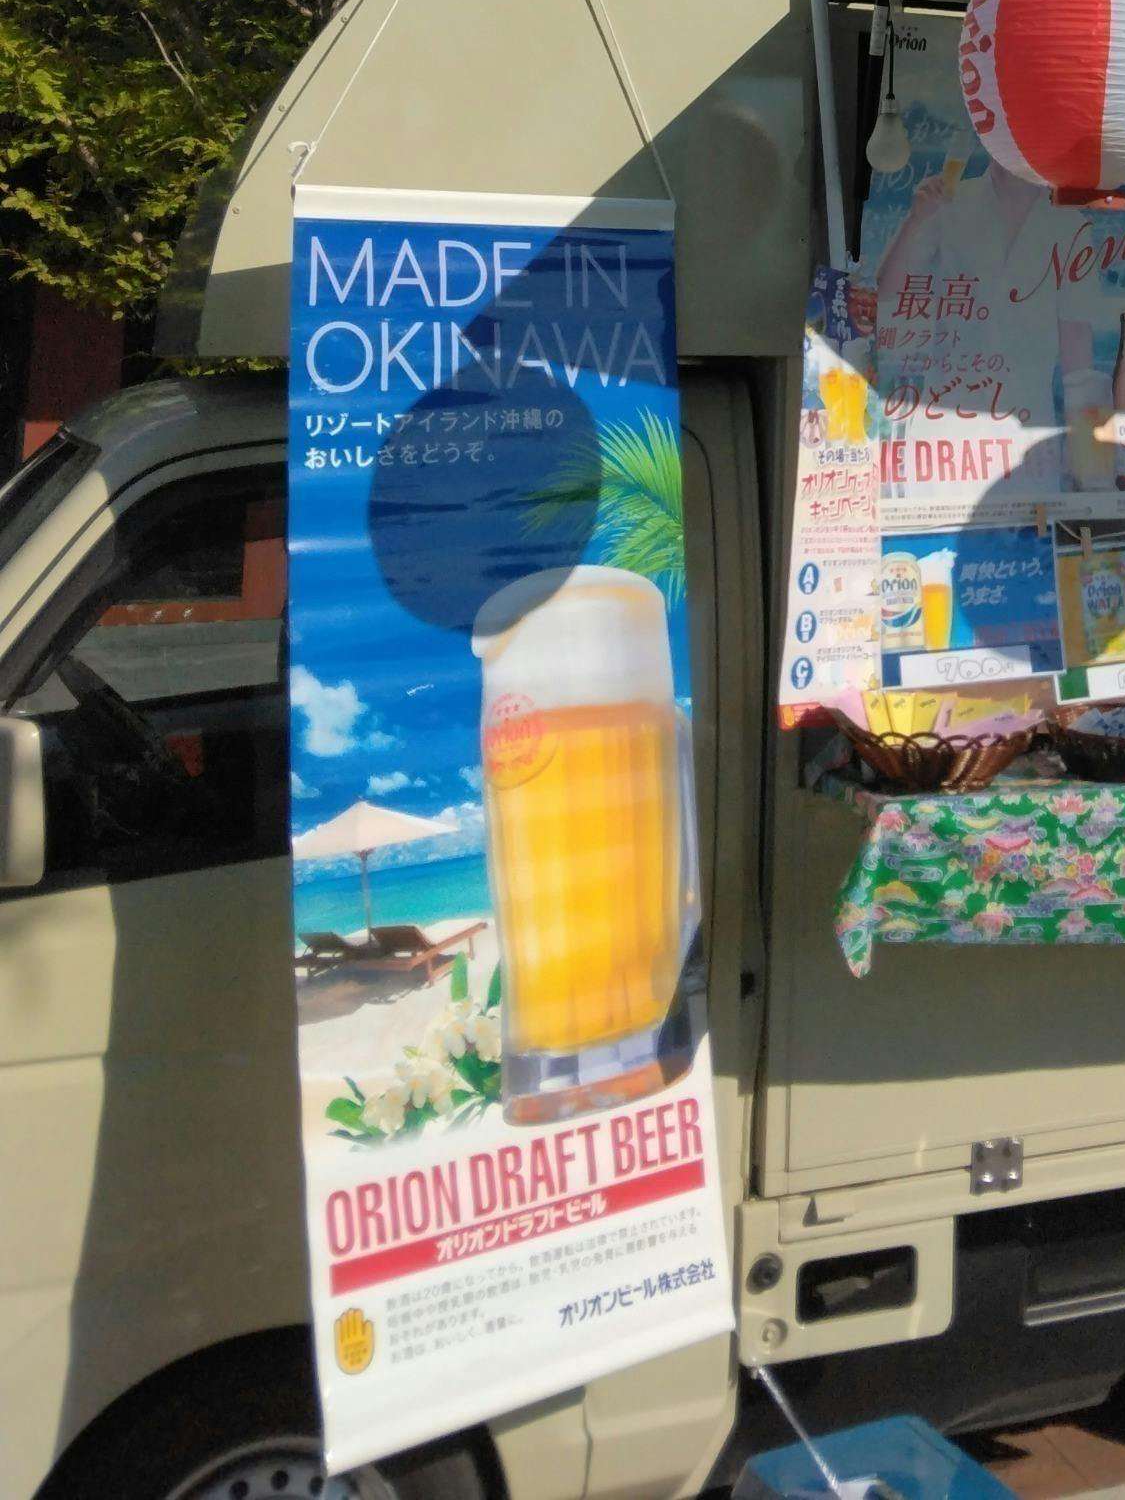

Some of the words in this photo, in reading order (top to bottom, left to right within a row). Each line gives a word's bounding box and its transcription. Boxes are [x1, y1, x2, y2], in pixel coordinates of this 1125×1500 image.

[308, 235, 533, 308] MADE
[564, 242, 630, 308] IN
[891, 273, 990, 321] 最高。
[305, 320, 667, 394] OKINAWA
[304, 408, 564, 438] リゾートアイランド沖縄の
[883, 376, 1032, 422] のどごし。
[303, 442, 497, 470] おいしさをどうぞ。
[914, 438, 1013, 484] DRAFT
[881, 577, 918, 594] Orion
[325, 1161, 462, 1257] ORION
[469, 1123, 602, 1216] DRAFT
[611, 1097, 704, 1179] BEER
[436, 1192, 608, 1263] オリオンドラフトビール
[558, 1257, 716, 1329] オリオンビール株式会社
